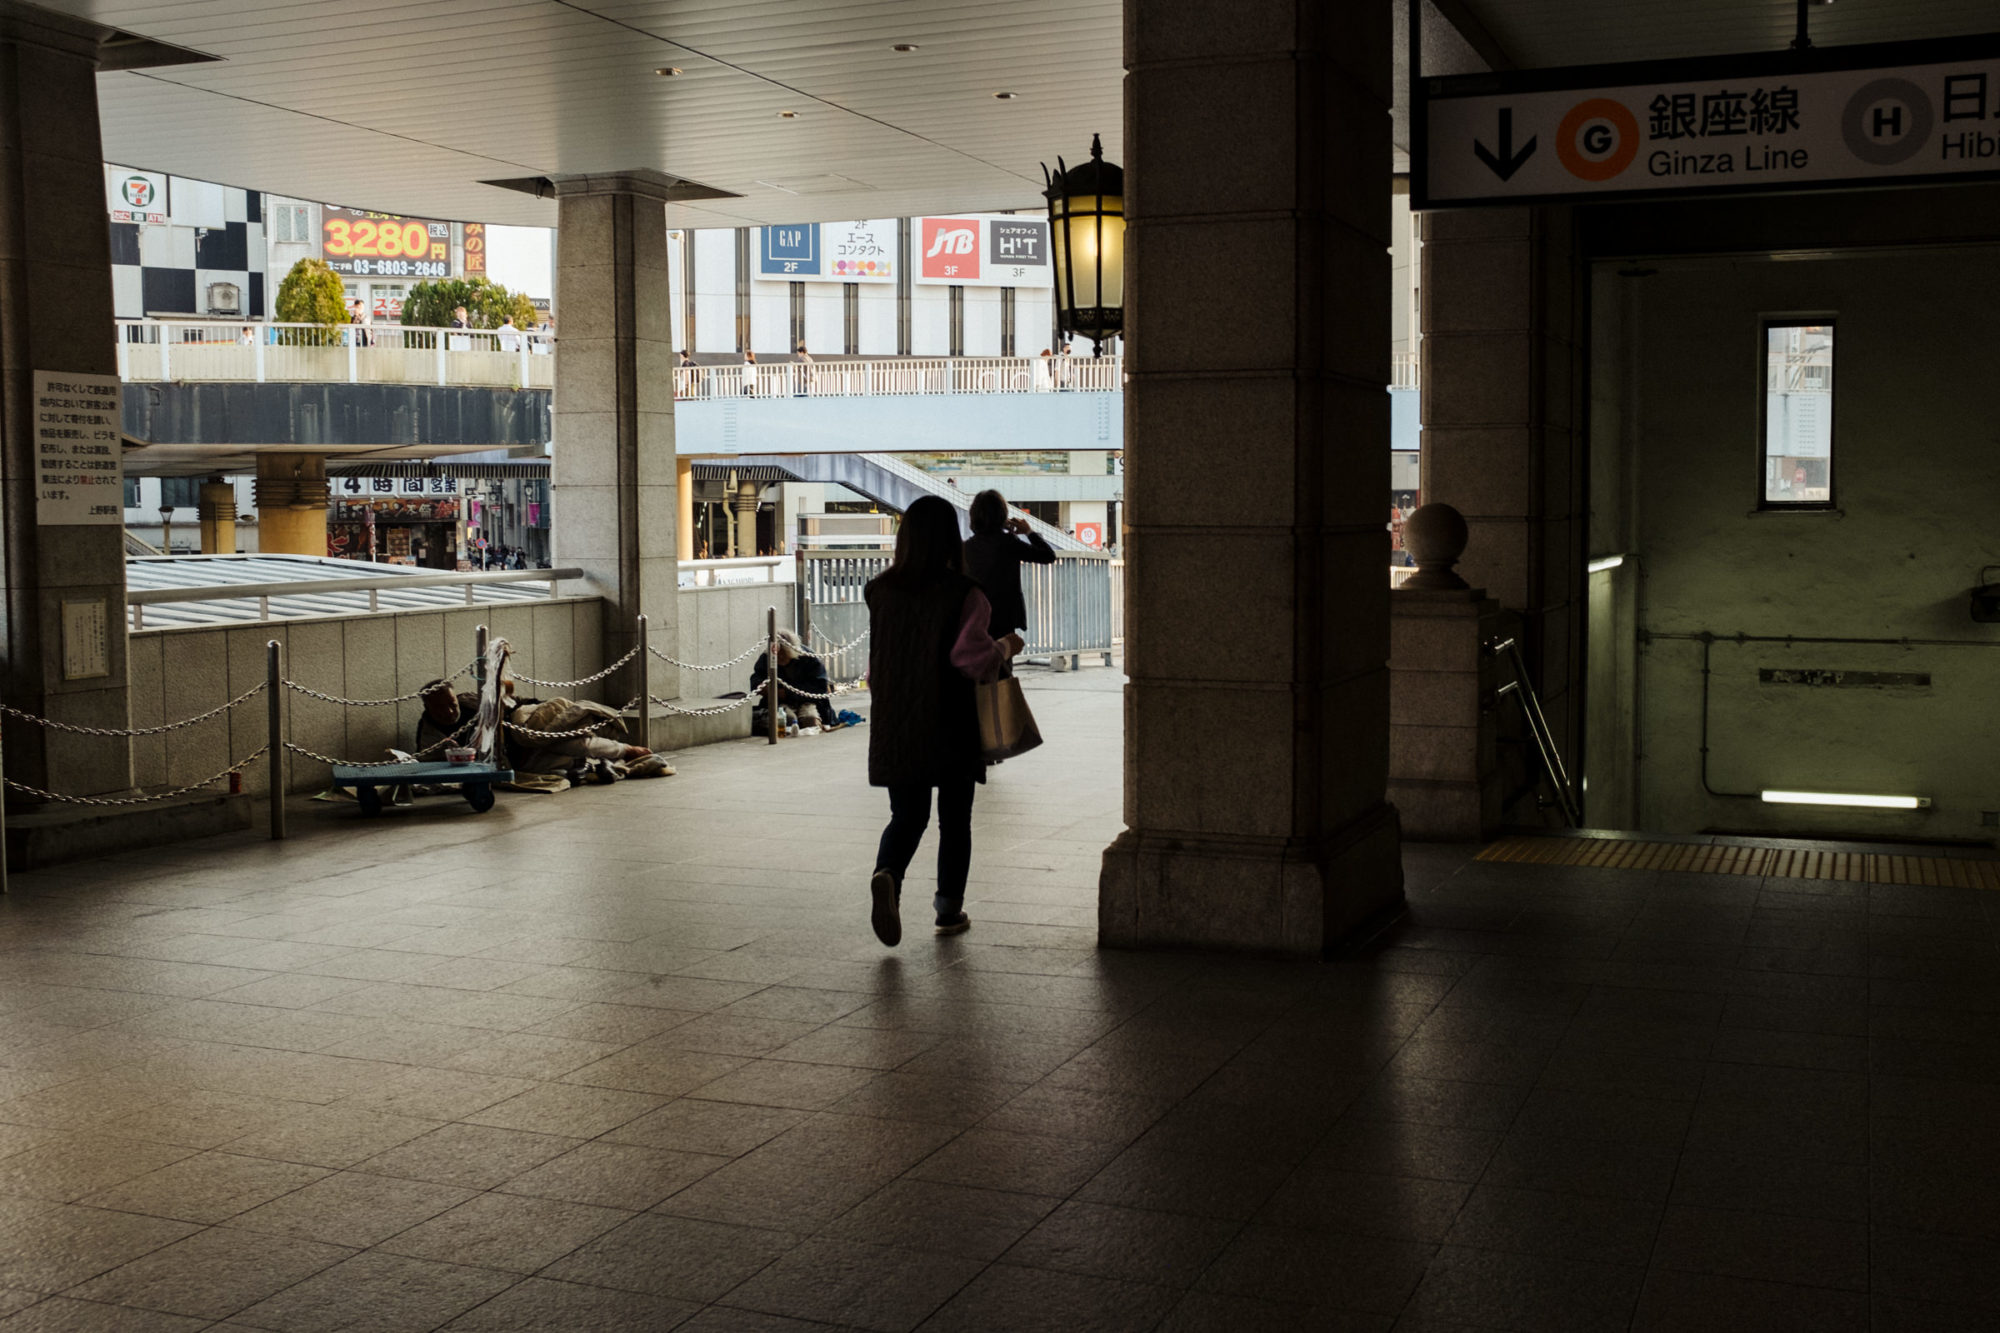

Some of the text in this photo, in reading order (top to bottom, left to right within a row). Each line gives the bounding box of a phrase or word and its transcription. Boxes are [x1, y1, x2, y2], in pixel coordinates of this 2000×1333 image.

[1943, 73, 2000, 122] 日
[1648, 86, 1801, 140] 銀座線
[1873, 107, 1901, 137] H
[1584, 125, 1612, 154] G
[1648, 145, 1809, 177] Ginza Line
[847, 232, 874, 244] エース
[999, 226, 1039, 236] シェアオフィス
[779, 229, 802, 248] GAP
[926, 227, 975, 258] JTB
[837, 244, 885, 256] コンタクト
[353, 259, 446, 276] 03-6803-2646
[784, 262, 799, 273] 2F
[944, 265, 959, 276] 3F
[1012, 267, 1026, 278] 3F
[43, 489, 70, 501] います。
[88, 505, 118, 516] 上野駅長
